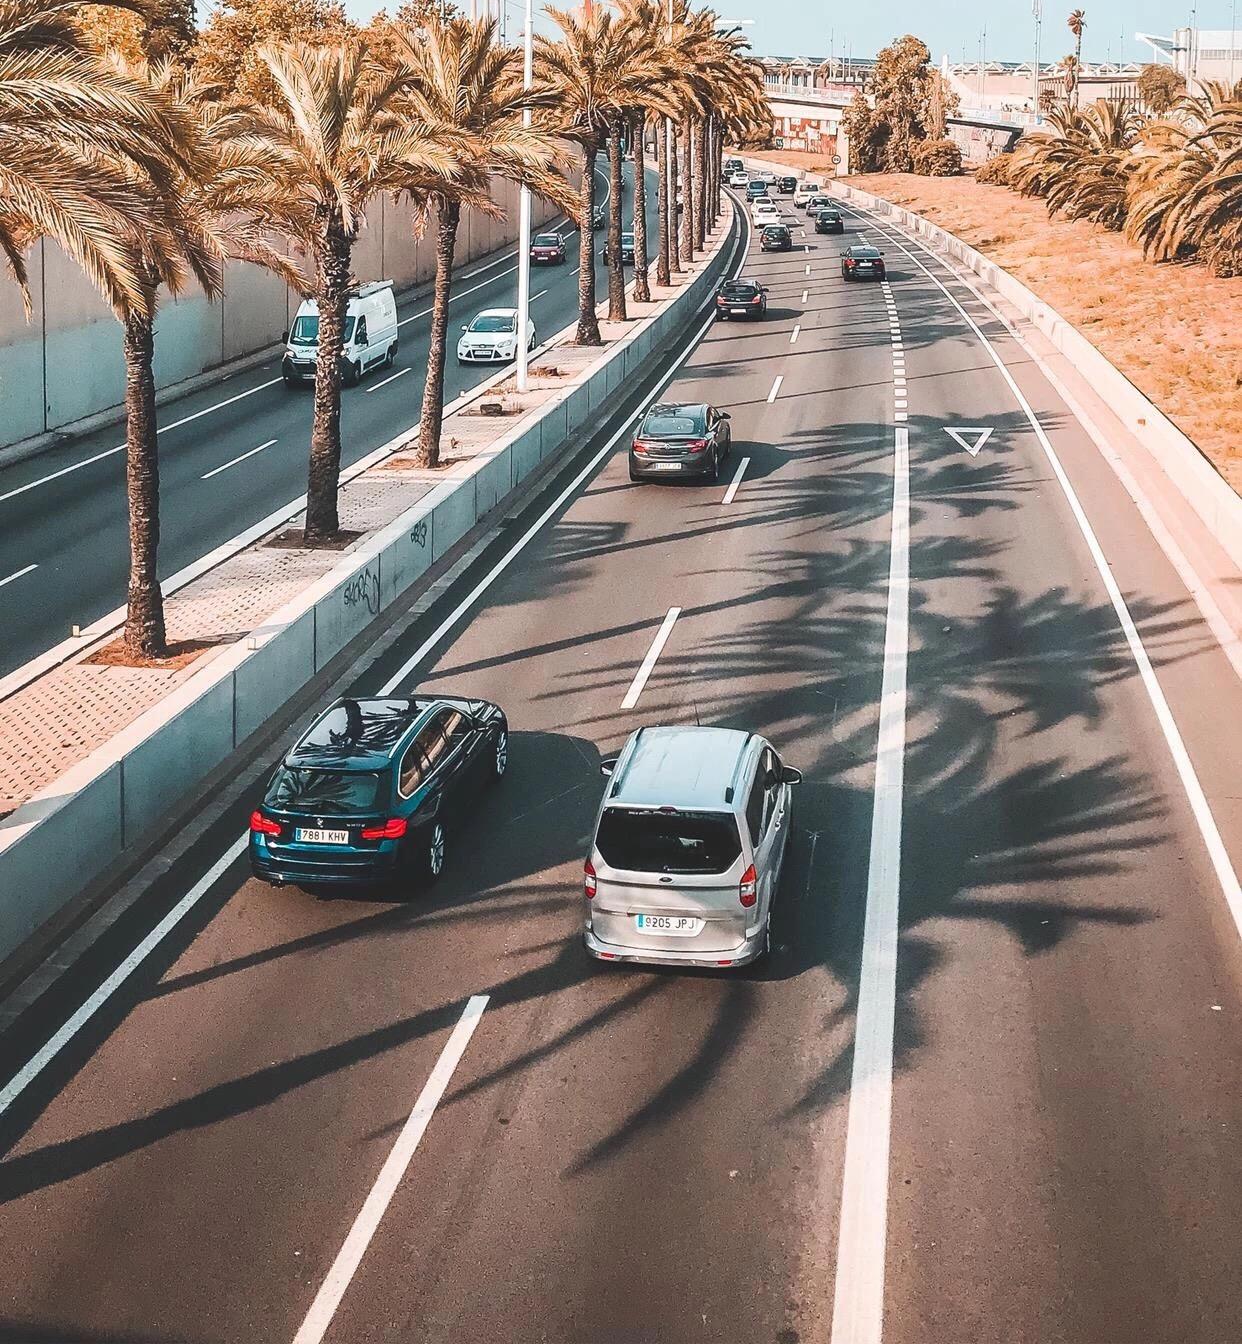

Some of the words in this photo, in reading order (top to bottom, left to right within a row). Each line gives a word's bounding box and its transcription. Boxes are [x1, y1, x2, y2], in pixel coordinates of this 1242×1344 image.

[303, 830, 325, 840] 7881
[328, 831, 346, 842] KHV
[645, 917, 671, 928] 9205
[675, 919, 695, 929] JPJ
